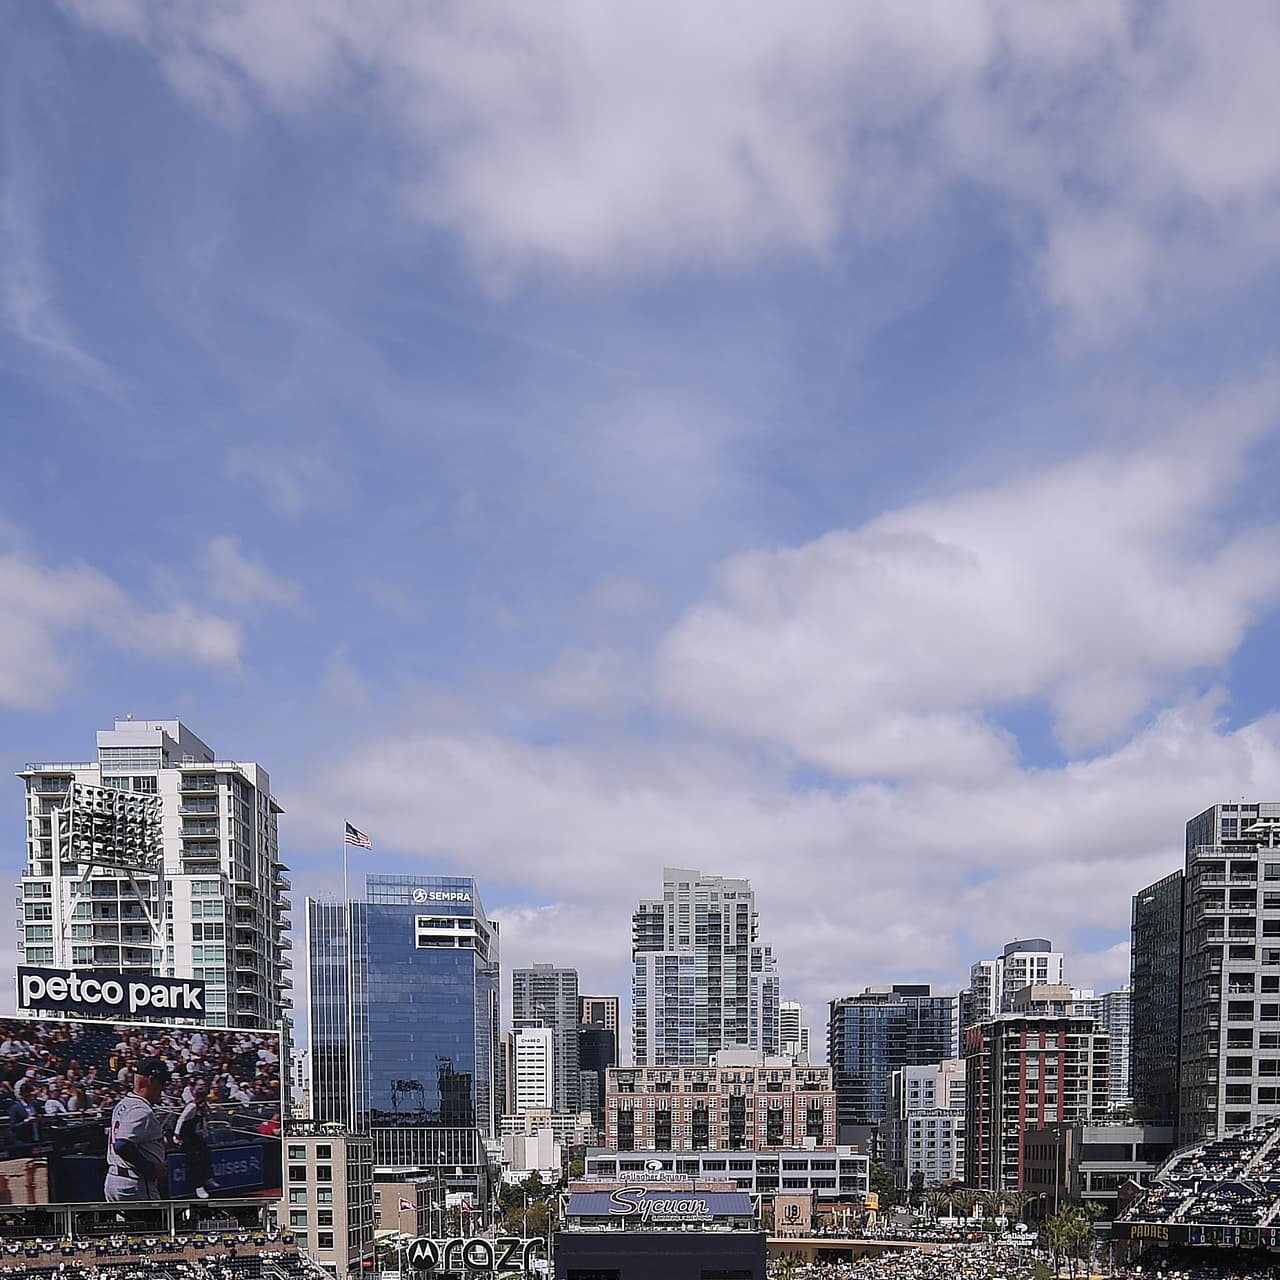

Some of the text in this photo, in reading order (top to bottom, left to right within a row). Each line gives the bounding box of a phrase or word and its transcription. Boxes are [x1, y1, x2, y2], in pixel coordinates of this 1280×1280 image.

[429, 891, 471, 902] SEMPRA
[22, 972, 203, 1013] petco park
[620, 1173, 658, 1182] Gallagher
[608, 1186, 710, 1222] Sycuan
[1131, 1225, 1169, 1241] PADRES
[444, 1237, 545, 1271] razr
